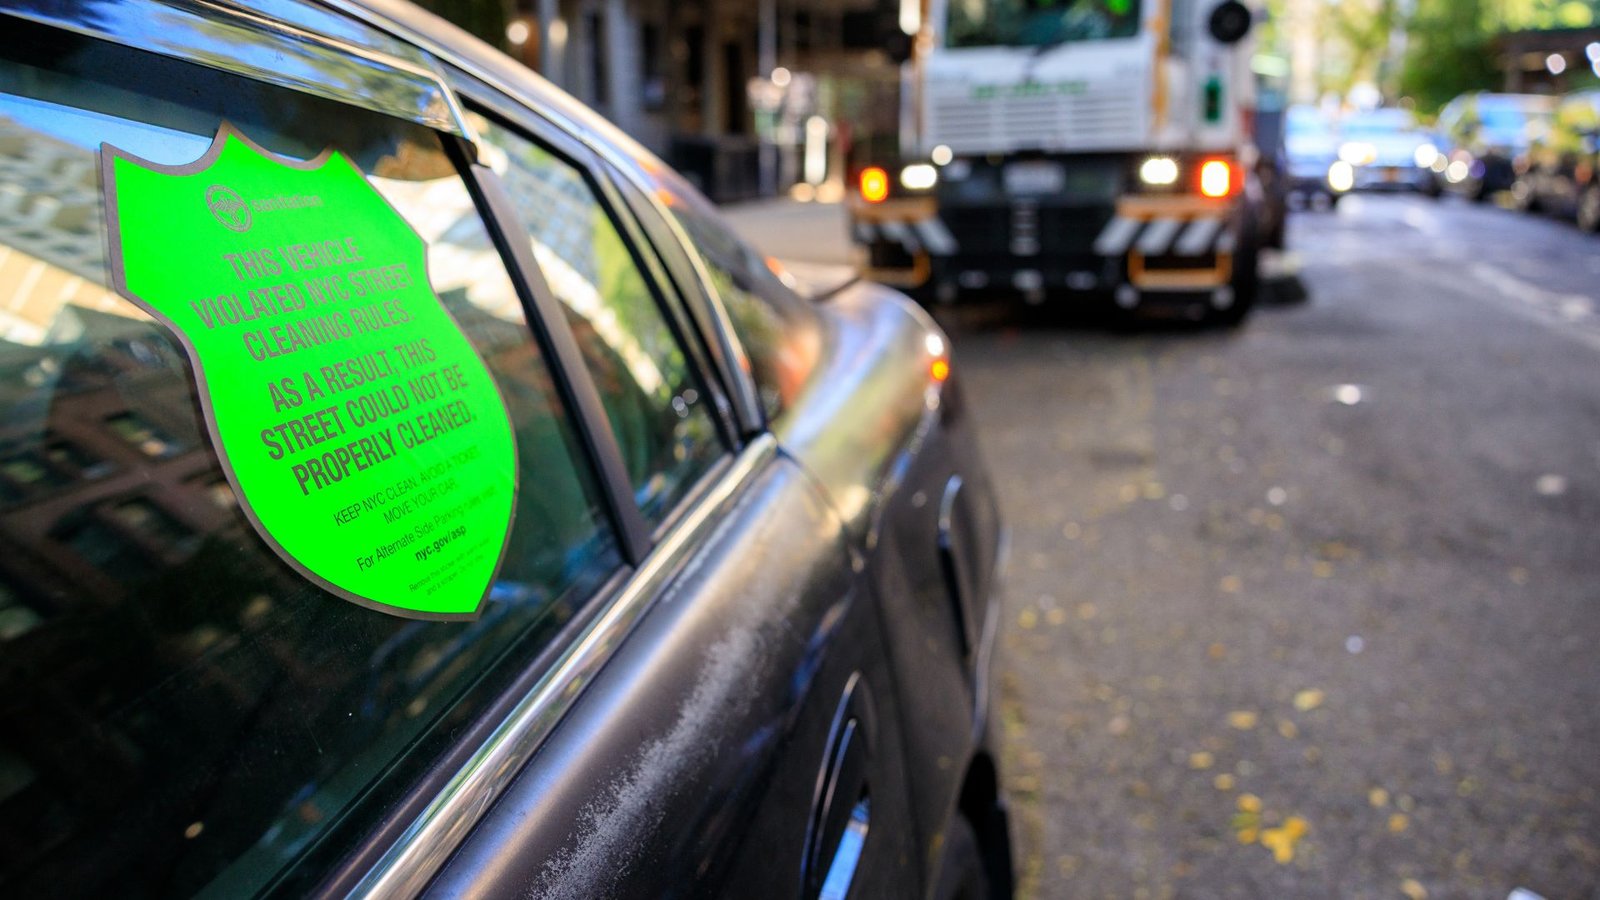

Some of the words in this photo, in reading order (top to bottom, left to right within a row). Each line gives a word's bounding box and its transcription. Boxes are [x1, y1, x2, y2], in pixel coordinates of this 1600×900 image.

[251, 193, 323, 213] sanitation
[222, 248, 282, 281] THIS
[279, 237, 364, 272] VEHICLE
[189, 283, 306, 330] VIOLATED
[304, 275, 350, 307] NYC
[348, 264, 414, 296] STREET
[243, 312, 352, 362] CLEANING
[349, 299, 415, 334] RULES.
[267, 377, 303, 413] AS
[303, 372, 325, 402] A
[320, 350, 401, 394] RESULT,
[394, 338, 436, 370] THIS
[260, 405, 346, 460] STREET
[345, 384, 410, 428] COULD
[408, 372, 443, 405] NOT
[443, 364, 469, 391] BE
[291, 428, 397, 496] PROPERLY
[397, 400, 477, 449] CLEANED.
[333, 503, 361, 527] KEEP
[362, 492, 386, 513] NYC
[420, 463, 446, 483] AVOID
[445, 459, 454, 472] A
[383, 500, 413, 525] MOVE
[411, 487, 439, 508] YOUR
[356, 557, 375, 572] For
[375, 533, 415, 563] Alternate
[414, 521, 435, 539] Side
[433, 504, 465, 526] Parking
[415, 524, 467, 562] nyc.gov/asp
